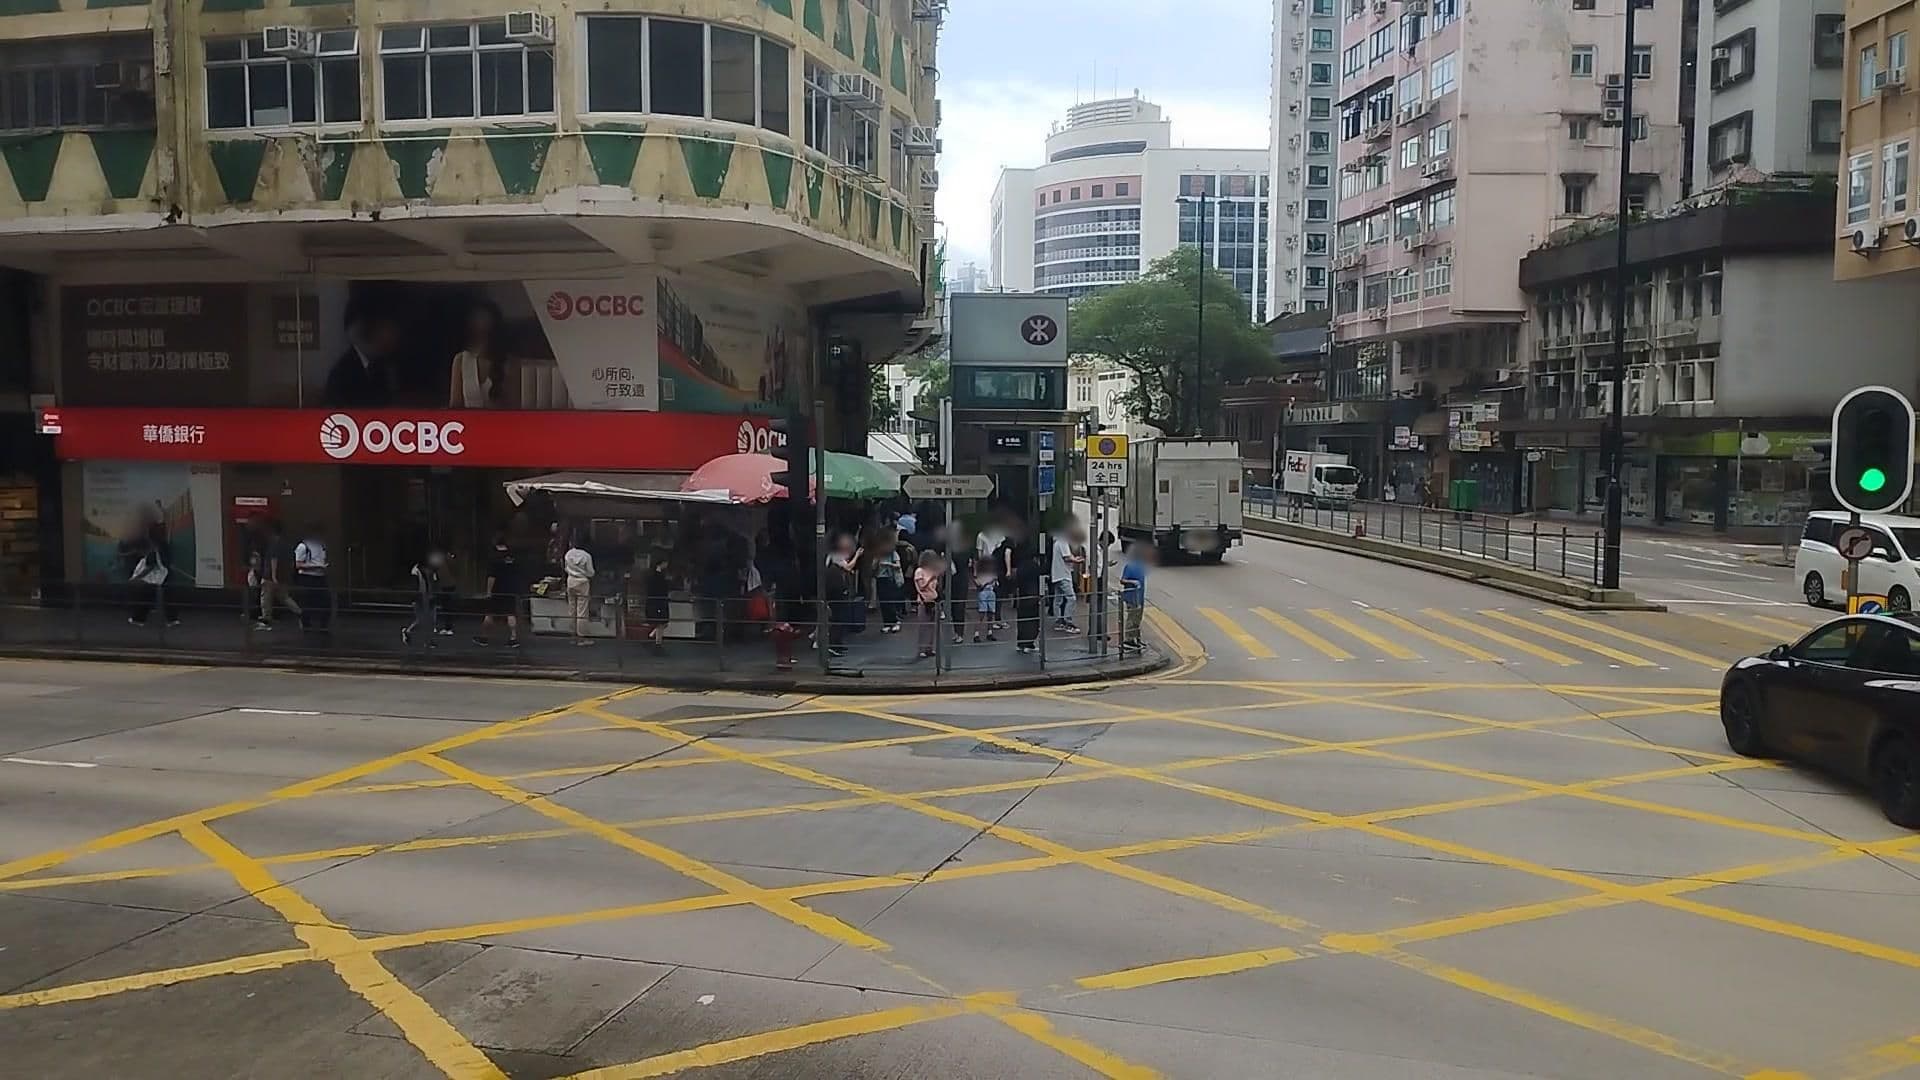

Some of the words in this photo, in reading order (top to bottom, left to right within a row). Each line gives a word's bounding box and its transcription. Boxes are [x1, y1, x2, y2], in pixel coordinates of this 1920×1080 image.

[575, 295, 644, 316] OCBC
[142, 424, 206, 444] 華僑銀行
[362, 420, 465, 454] OCBC
[1091, 461, 1105, 470] 24
[1107, 461, 1122, 470] hrs
[1095, 472, 1119, 483] 全日
